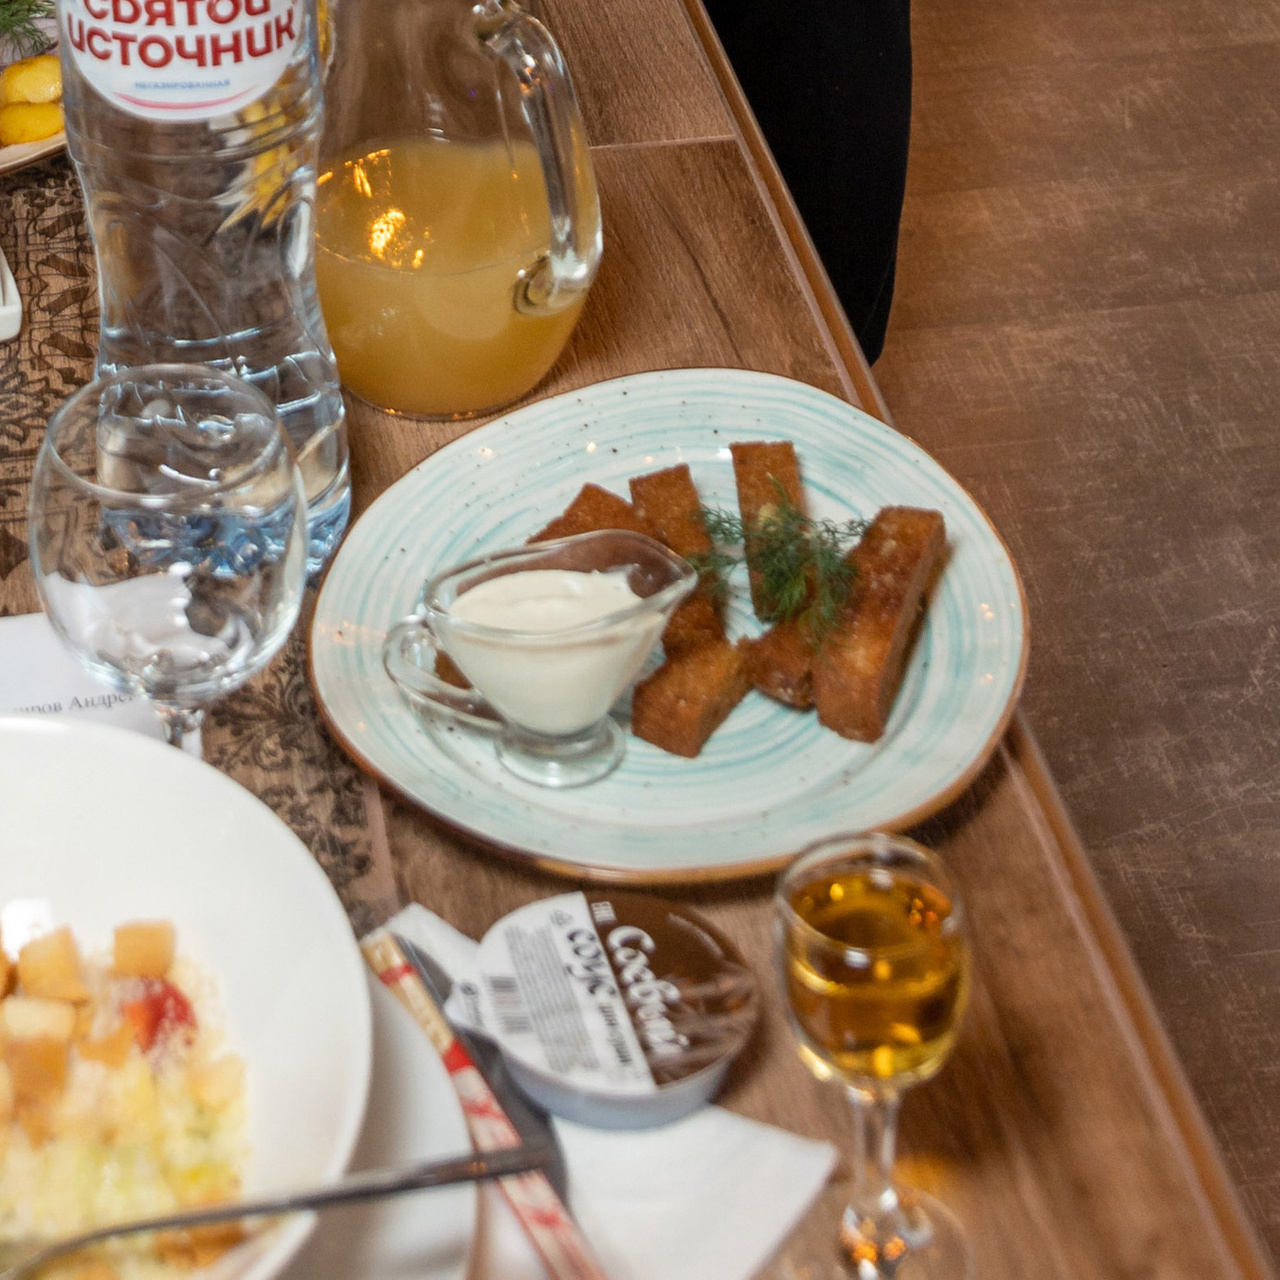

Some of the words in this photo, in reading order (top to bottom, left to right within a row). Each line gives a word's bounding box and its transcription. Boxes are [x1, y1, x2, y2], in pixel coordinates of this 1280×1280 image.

[67, 6, 296, 69] ИСТОЧНИК
[134, 78, 230, 90] НЕГАЗИРОВАННАЯ
[565, 928, 617, 998] соус
[607, 925, 691, 1062] Соевый
